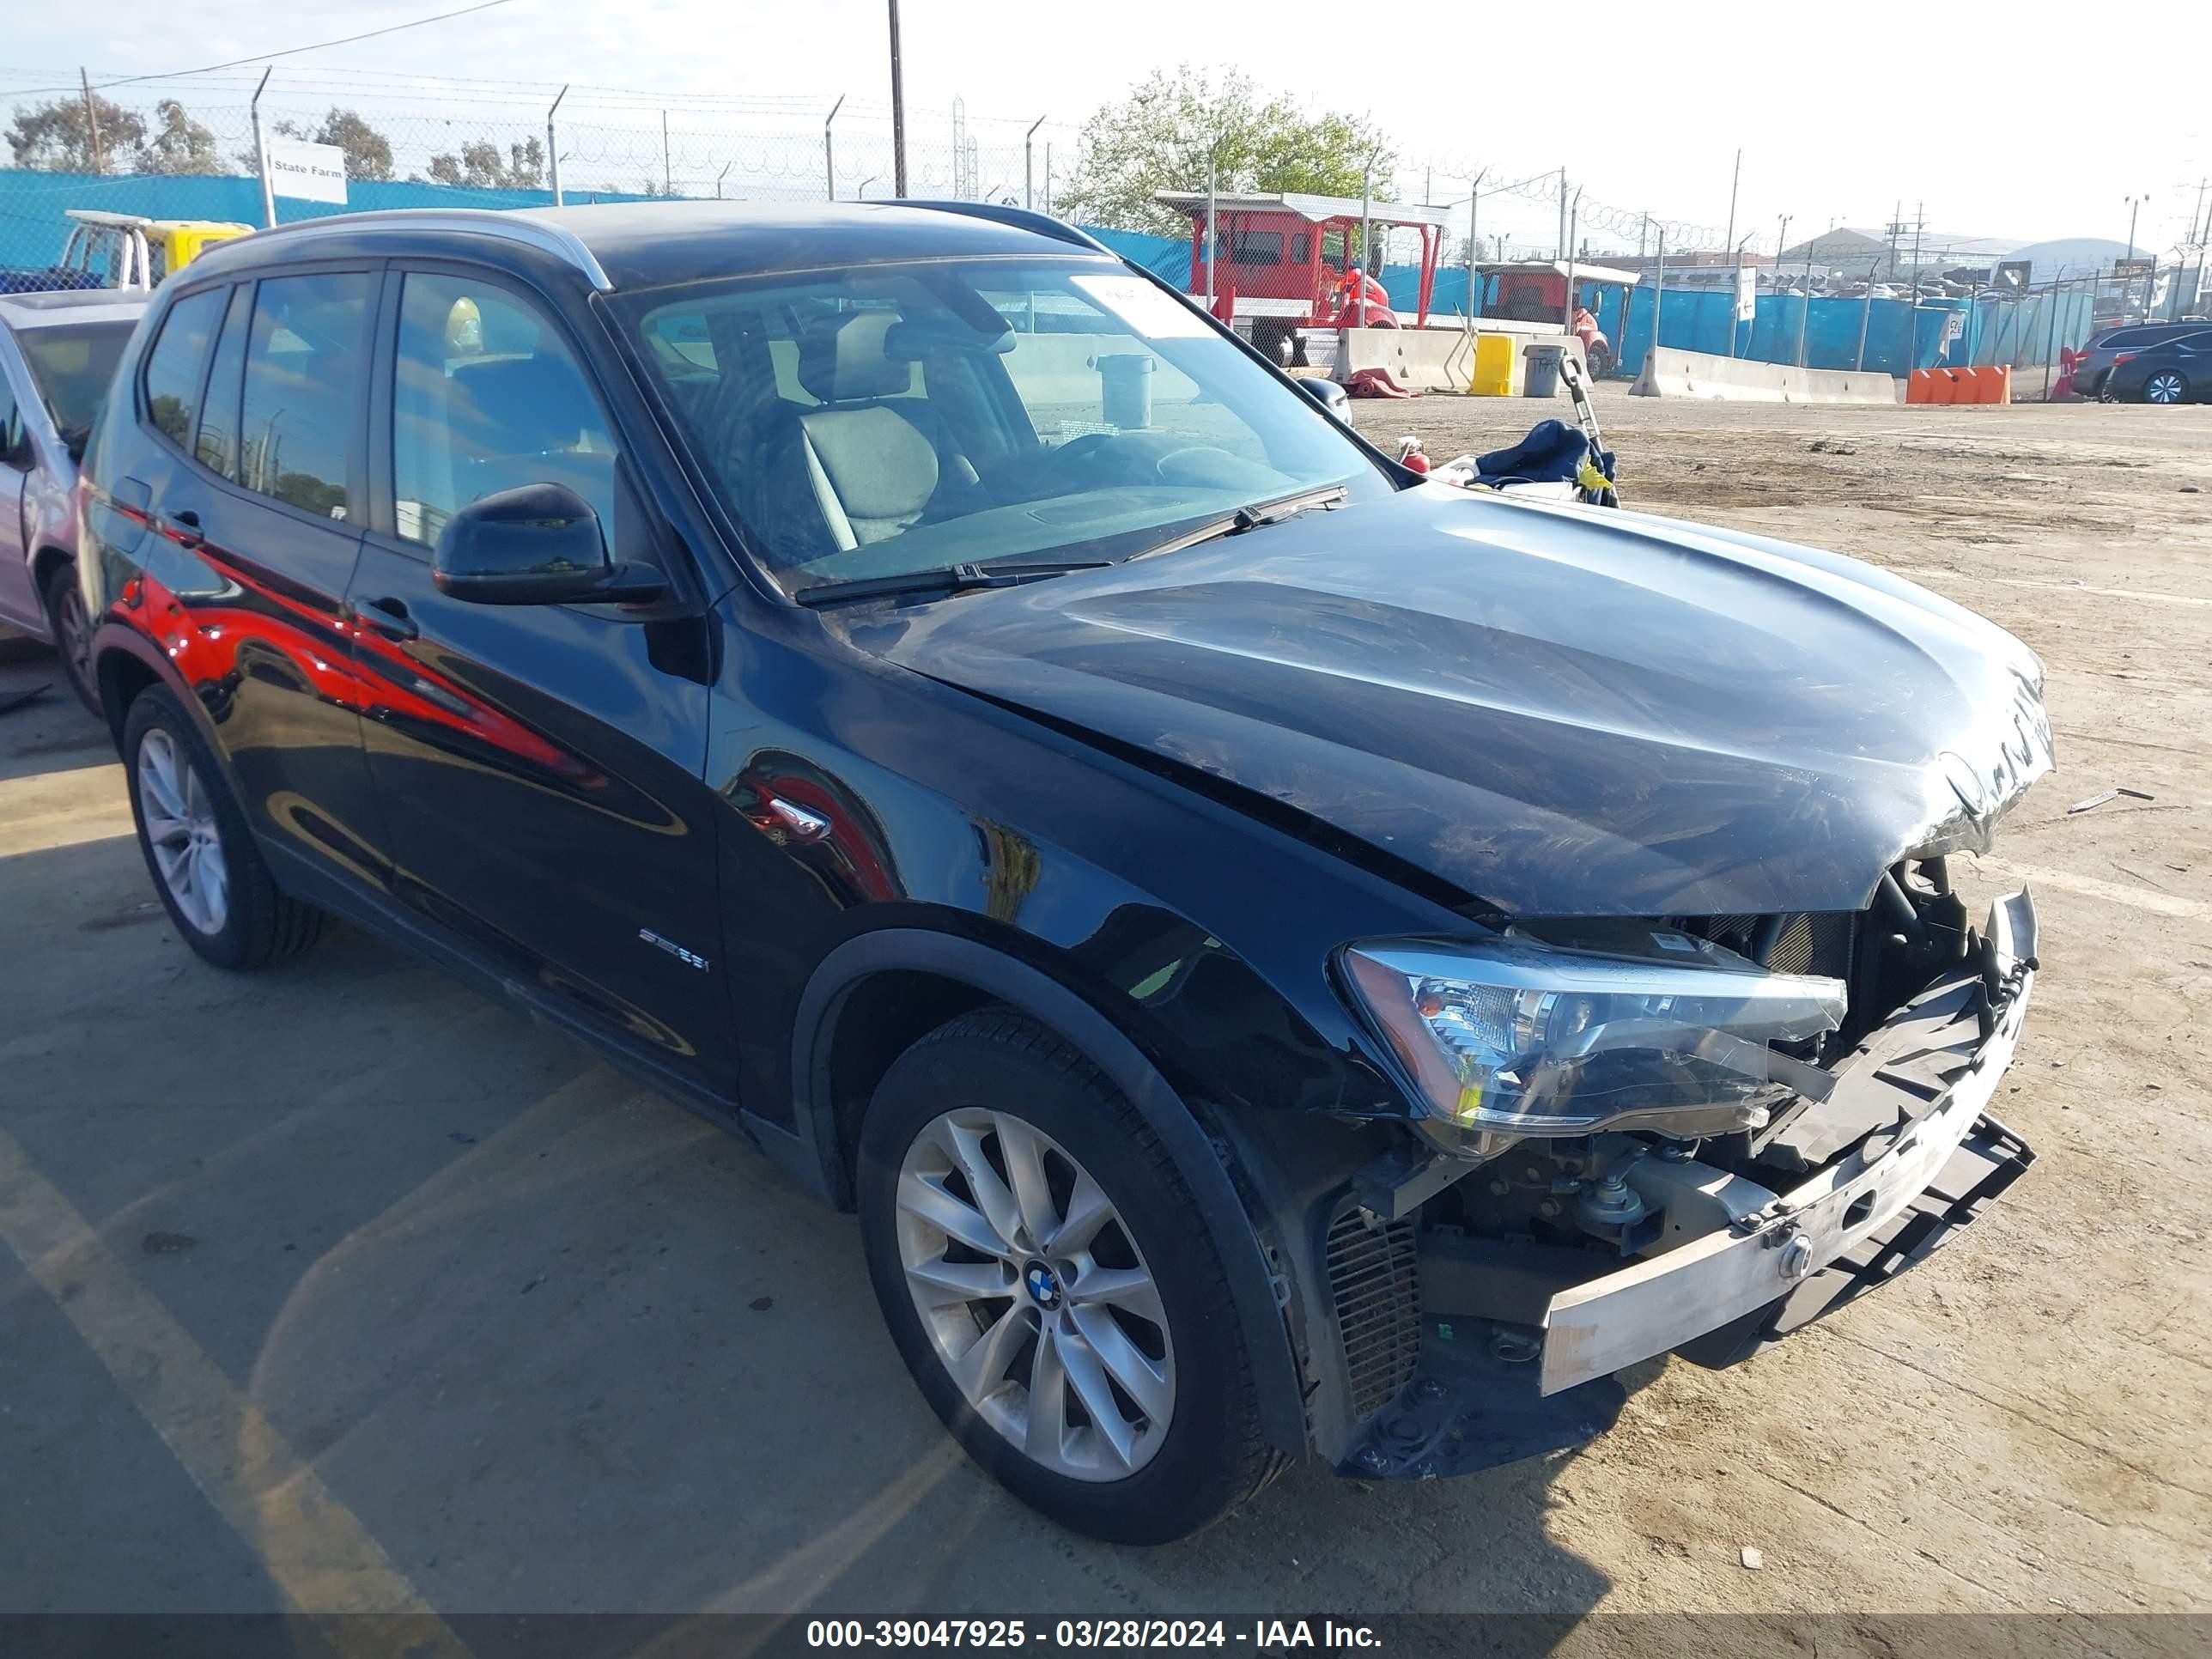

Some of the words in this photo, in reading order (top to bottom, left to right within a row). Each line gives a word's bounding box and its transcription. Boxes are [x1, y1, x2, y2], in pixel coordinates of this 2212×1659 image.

[274, 160, 307, 173] State
[311, 165, 343, 179] Farm
[1528, 357, 1559, 374] TRAS
